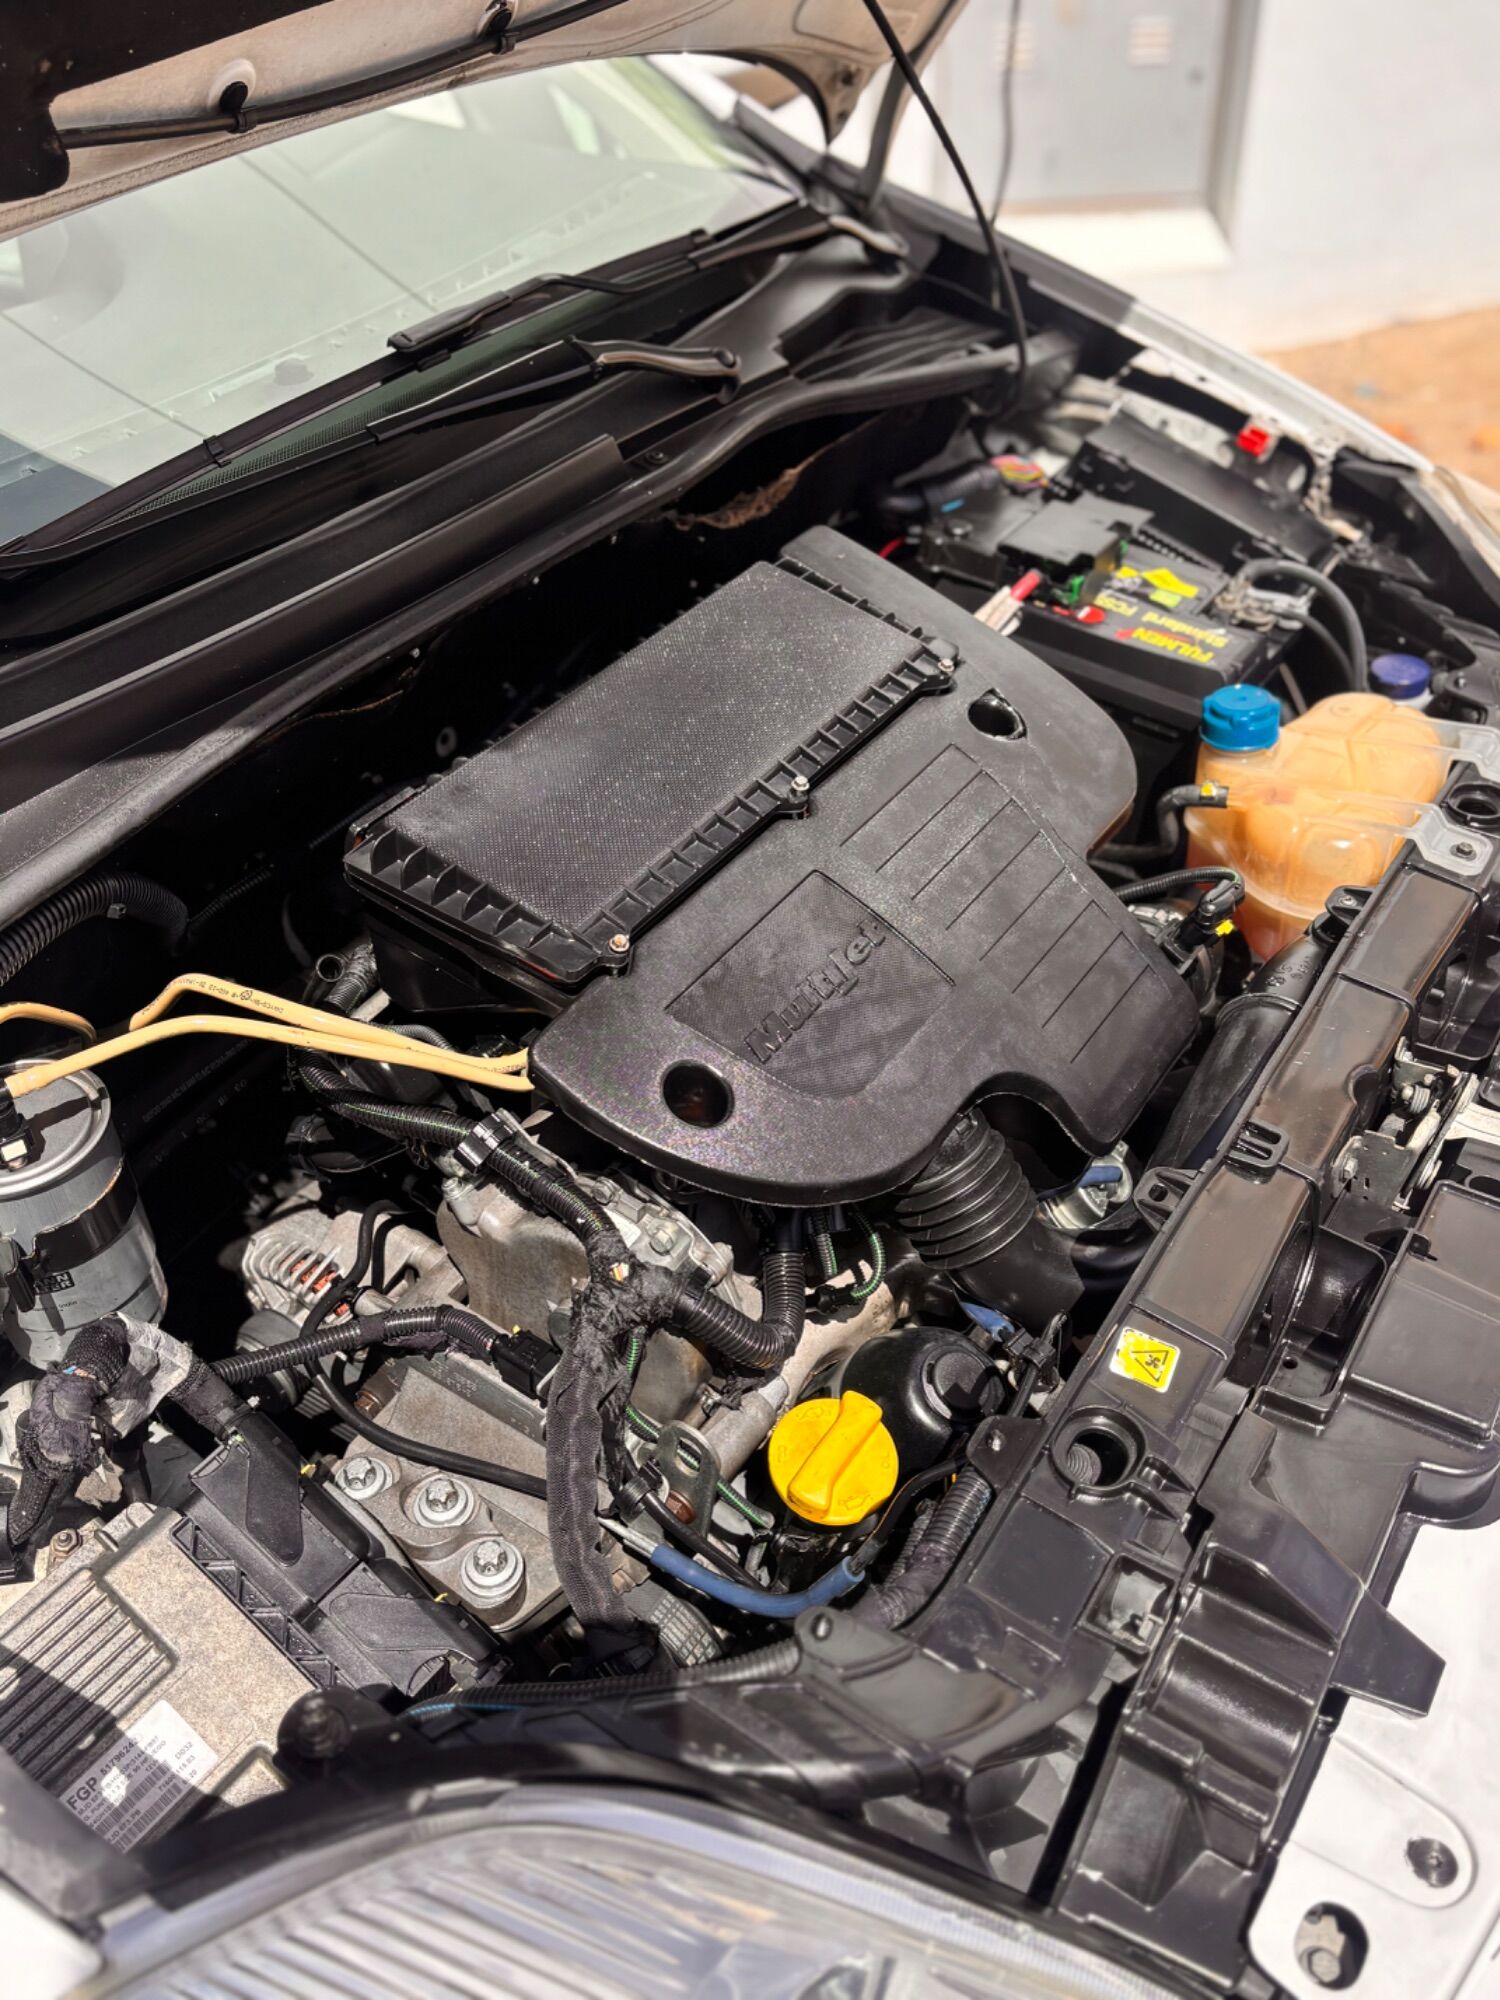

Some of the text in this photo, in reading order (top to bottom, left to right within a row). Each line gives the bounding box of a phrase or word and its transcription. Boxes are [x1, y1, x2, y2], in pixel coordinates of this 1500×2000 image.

[1132, 627, 1215, 663] FULMEN
[1141, 610, 1230, 648] Standard
[67, 1777, 99, 1811] FGP
